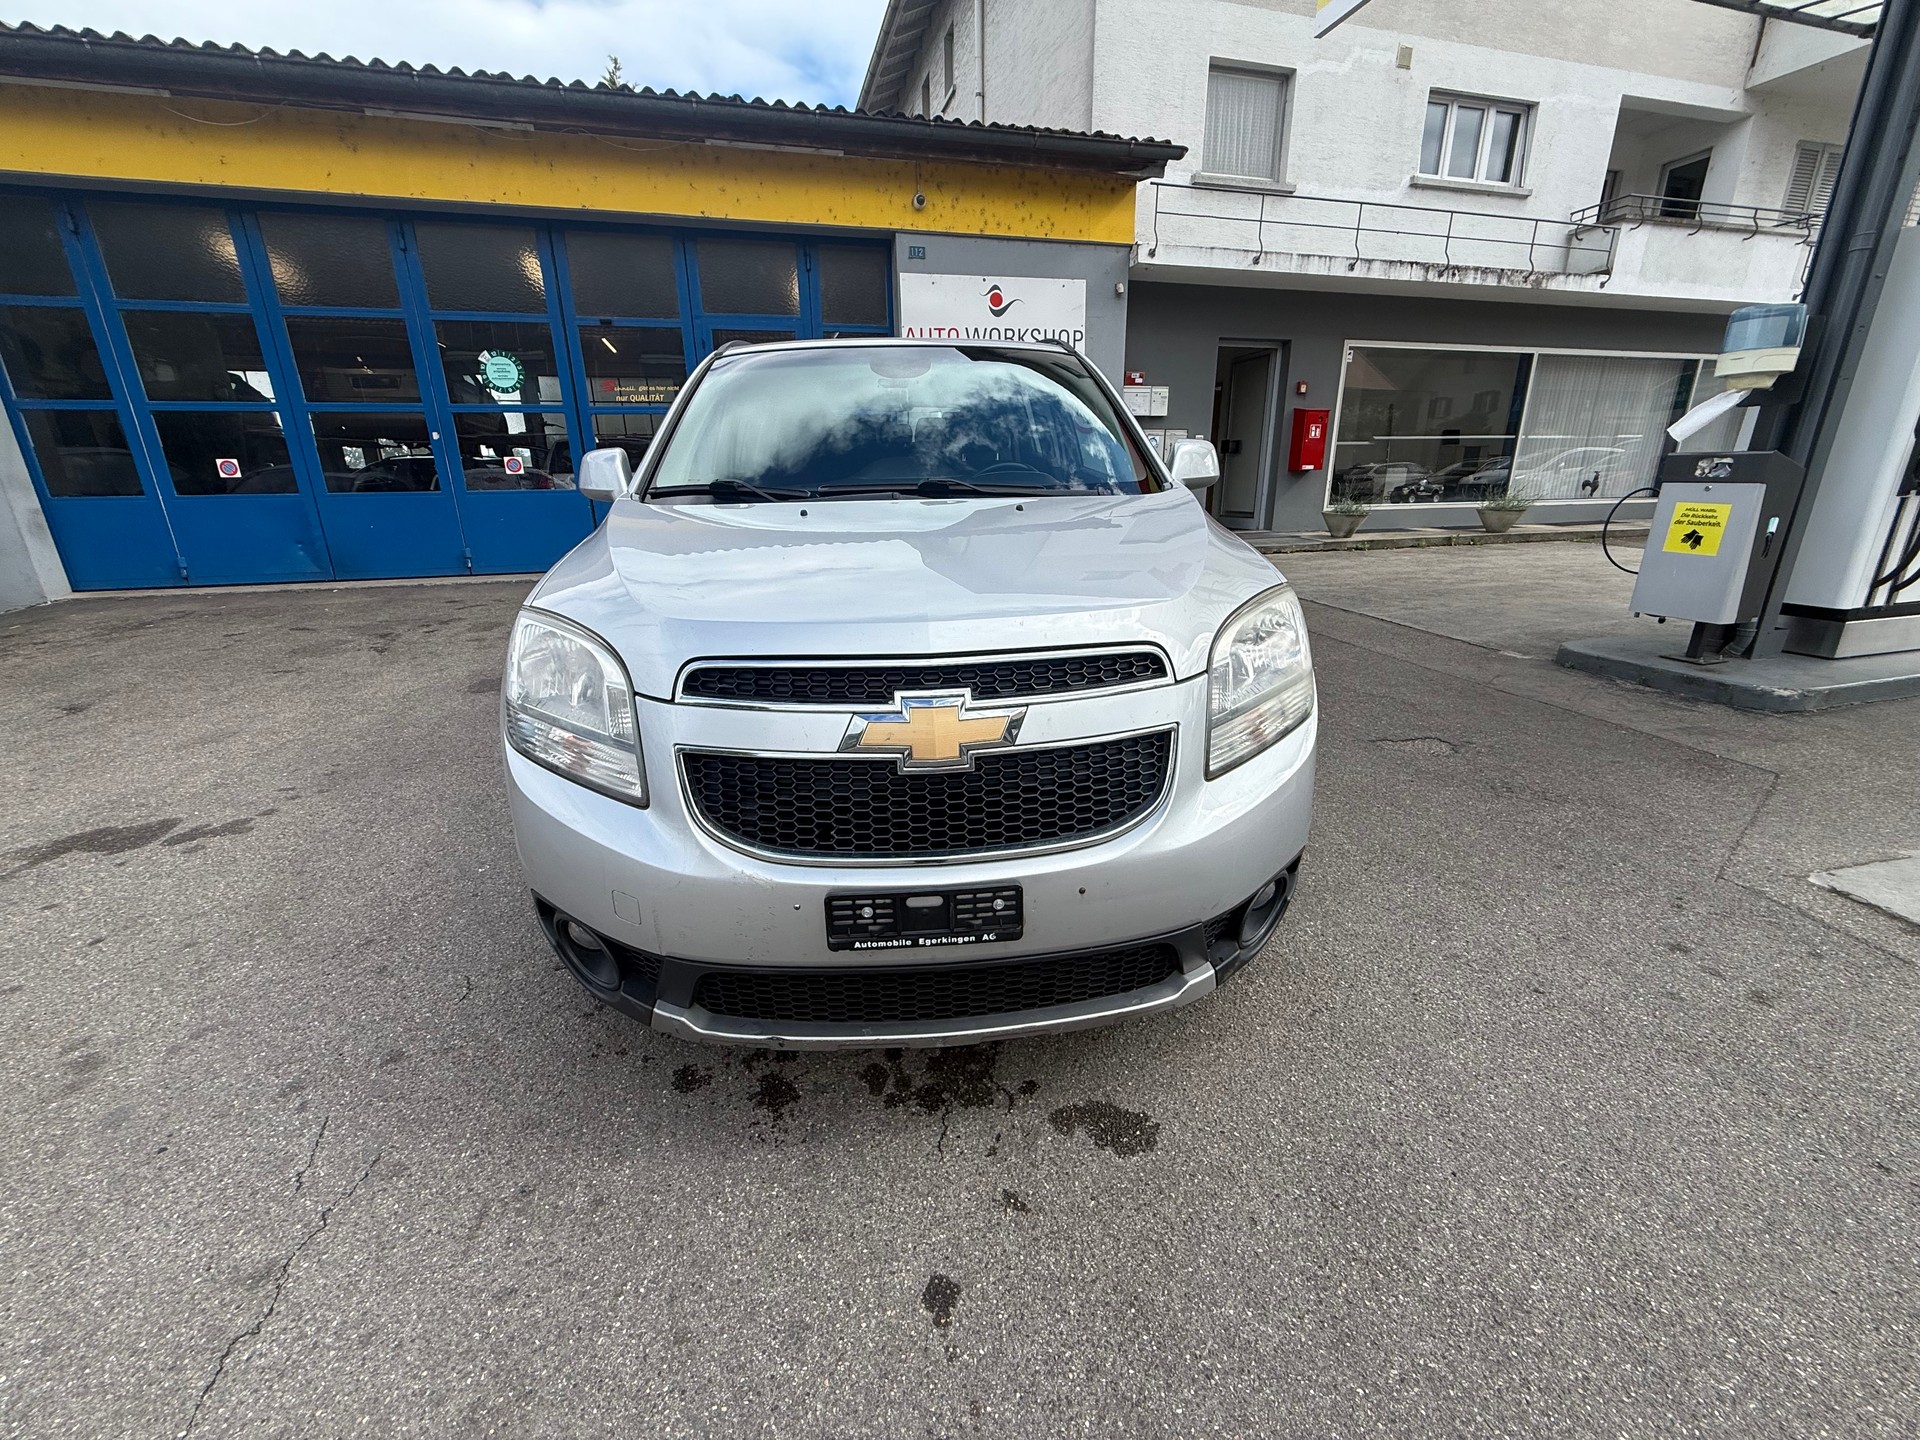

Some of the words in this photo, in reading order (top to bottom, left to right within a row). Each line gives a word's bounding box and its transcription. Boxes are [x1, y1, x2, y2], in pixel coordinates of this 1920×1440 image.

[911, 248, 924, 256] 112
[965, 327, 1084, 350] WORKSHOP
[629, 393, 665, 402] QUALITÄT
[854, 938, 912, 948] Automobile
[918, 935, 976, 946] Egerkingen
[982, 932, 997, 941] AG
